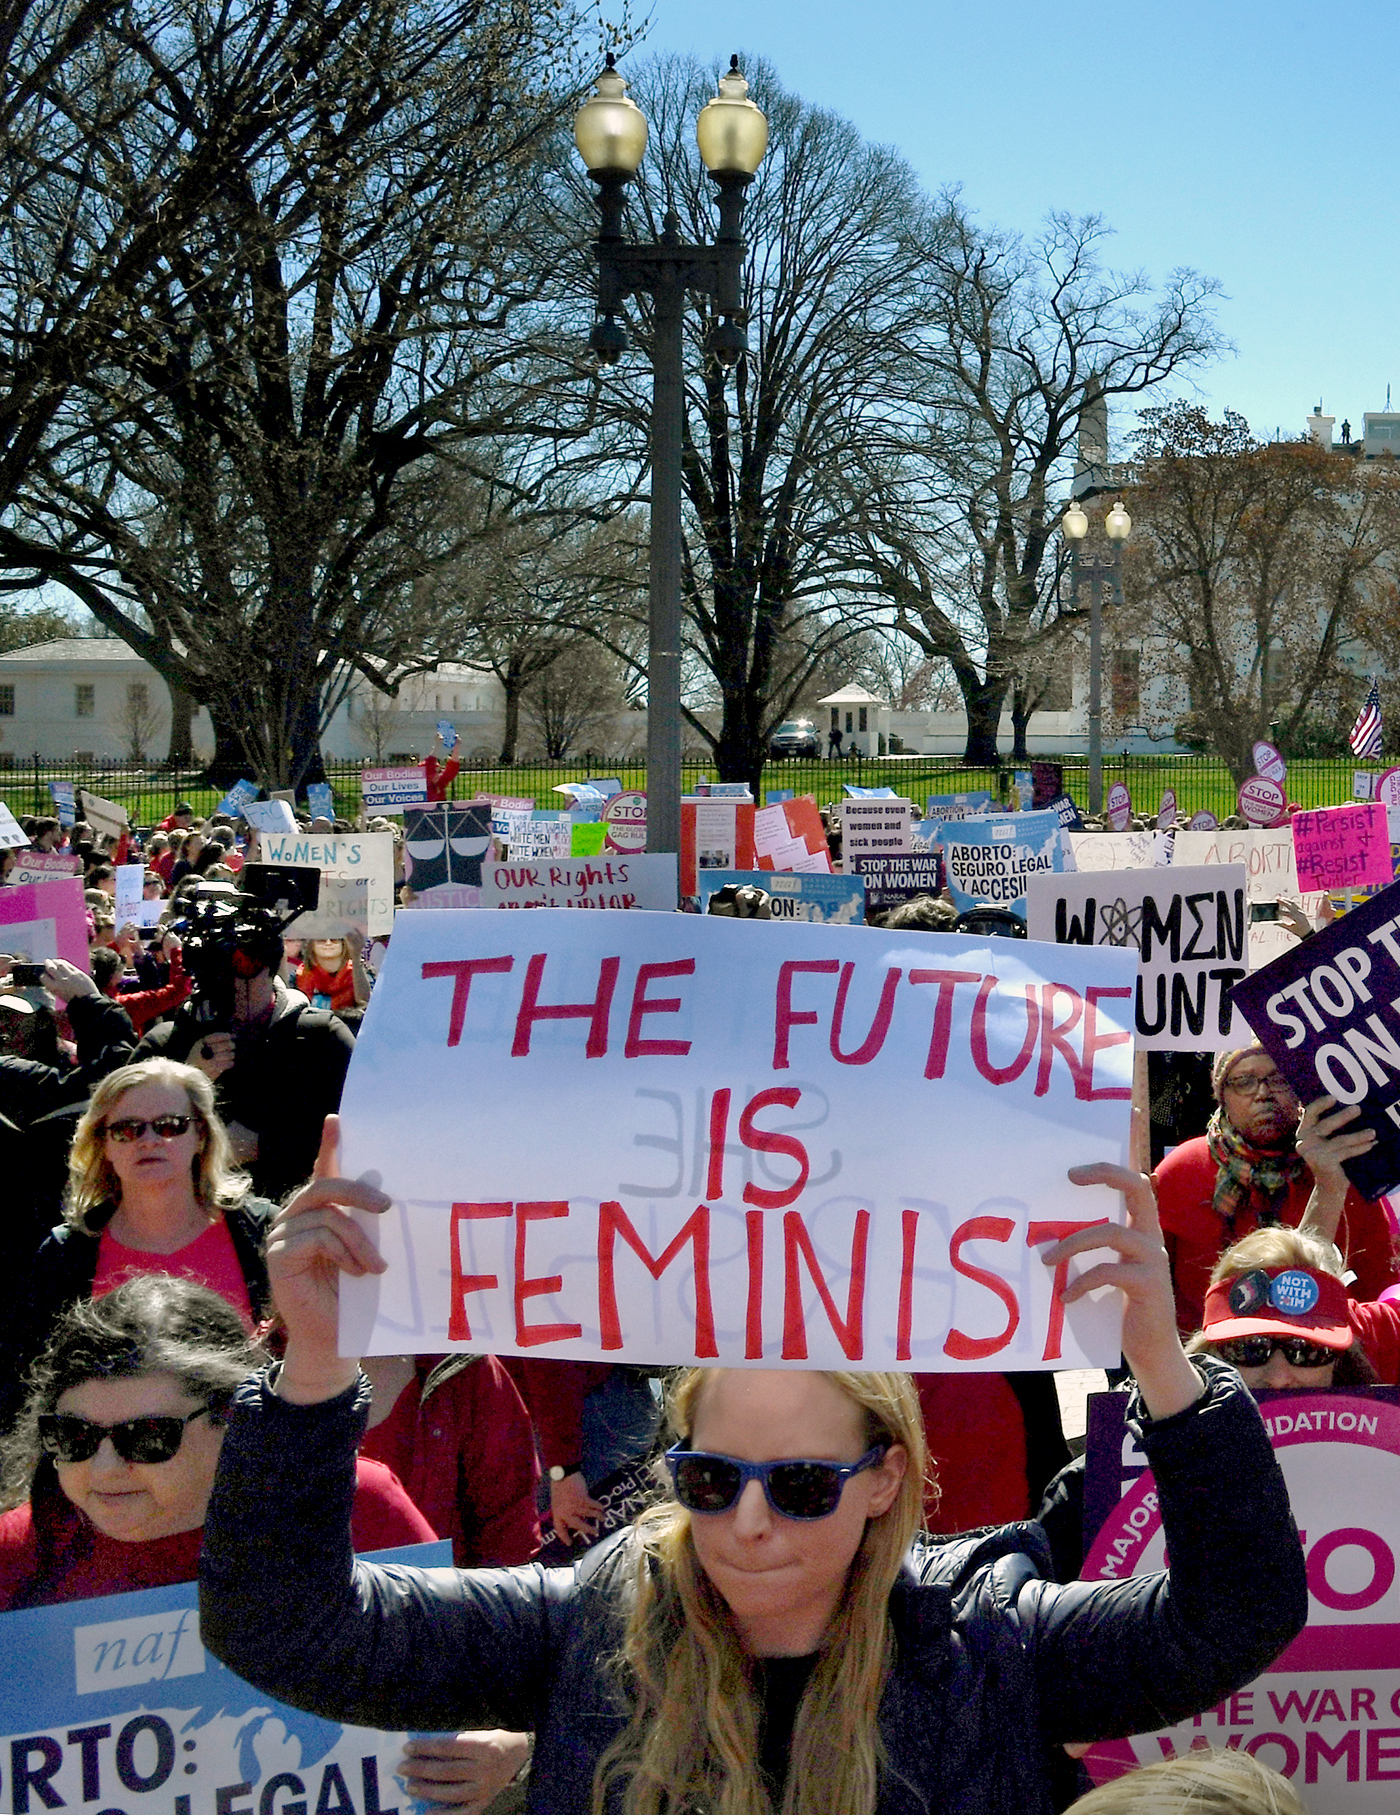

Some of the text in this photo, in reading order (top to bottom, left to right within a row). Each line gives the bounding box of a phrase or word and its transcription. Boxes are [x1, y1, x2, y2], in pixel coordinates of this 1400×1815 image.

[364, 770, 423, 780] Our Bodies
[369, 782, 419, 792] Our Lives
[1248, 785, 1279, 801] STOP
[366, 793, 424, 804] Our Voices
[501, 798, 534, 809] Bodies
[1053, 798, 1071, 813] WAR
[503, 812, 528, 821] Lives
[846, 806, 906, 815] Because even
[1244, 804, 1276, 818] WOMEN
[850, 821, 901, 831] women and
[1295, 805, 1376, 837] #Persist
[850, 837, 903, 848] sick people
[1297, 833, 1347, 857] against
[951, 845, 1016, 861] ABORTO:
[21, 856, 75, 871] Our Bodies
[861, 859, 937, 872] STOP THE WAR
[1012, 855, 1052, 874] LEGAL
[1296, 849, 1369, 874] #Resist
[20, 871, 41, 883] Our
[355, 876, 376, 887] are
[494, 862, 630, 897] OUR Rights
[864, 874, 882, 889] ON
[885, 872, 936, 889] WOMEN
[959, 875, 1028, 900] Y ACCESI
[1266, 947, 1373, 1050] STOP
[421, 952, 1134, 1102] THE FUTURE
[707, 1087, 811, 1209] IS
[448, 1200, 1111, 1363] FEMINIST
[1282, 1275, 1309, 1288] NOT
[1277, 1285, 1311, 1299] WITH
[94, 1609, 190, 1682] naf
[1268, 1687, 1377, 1725] WAR
